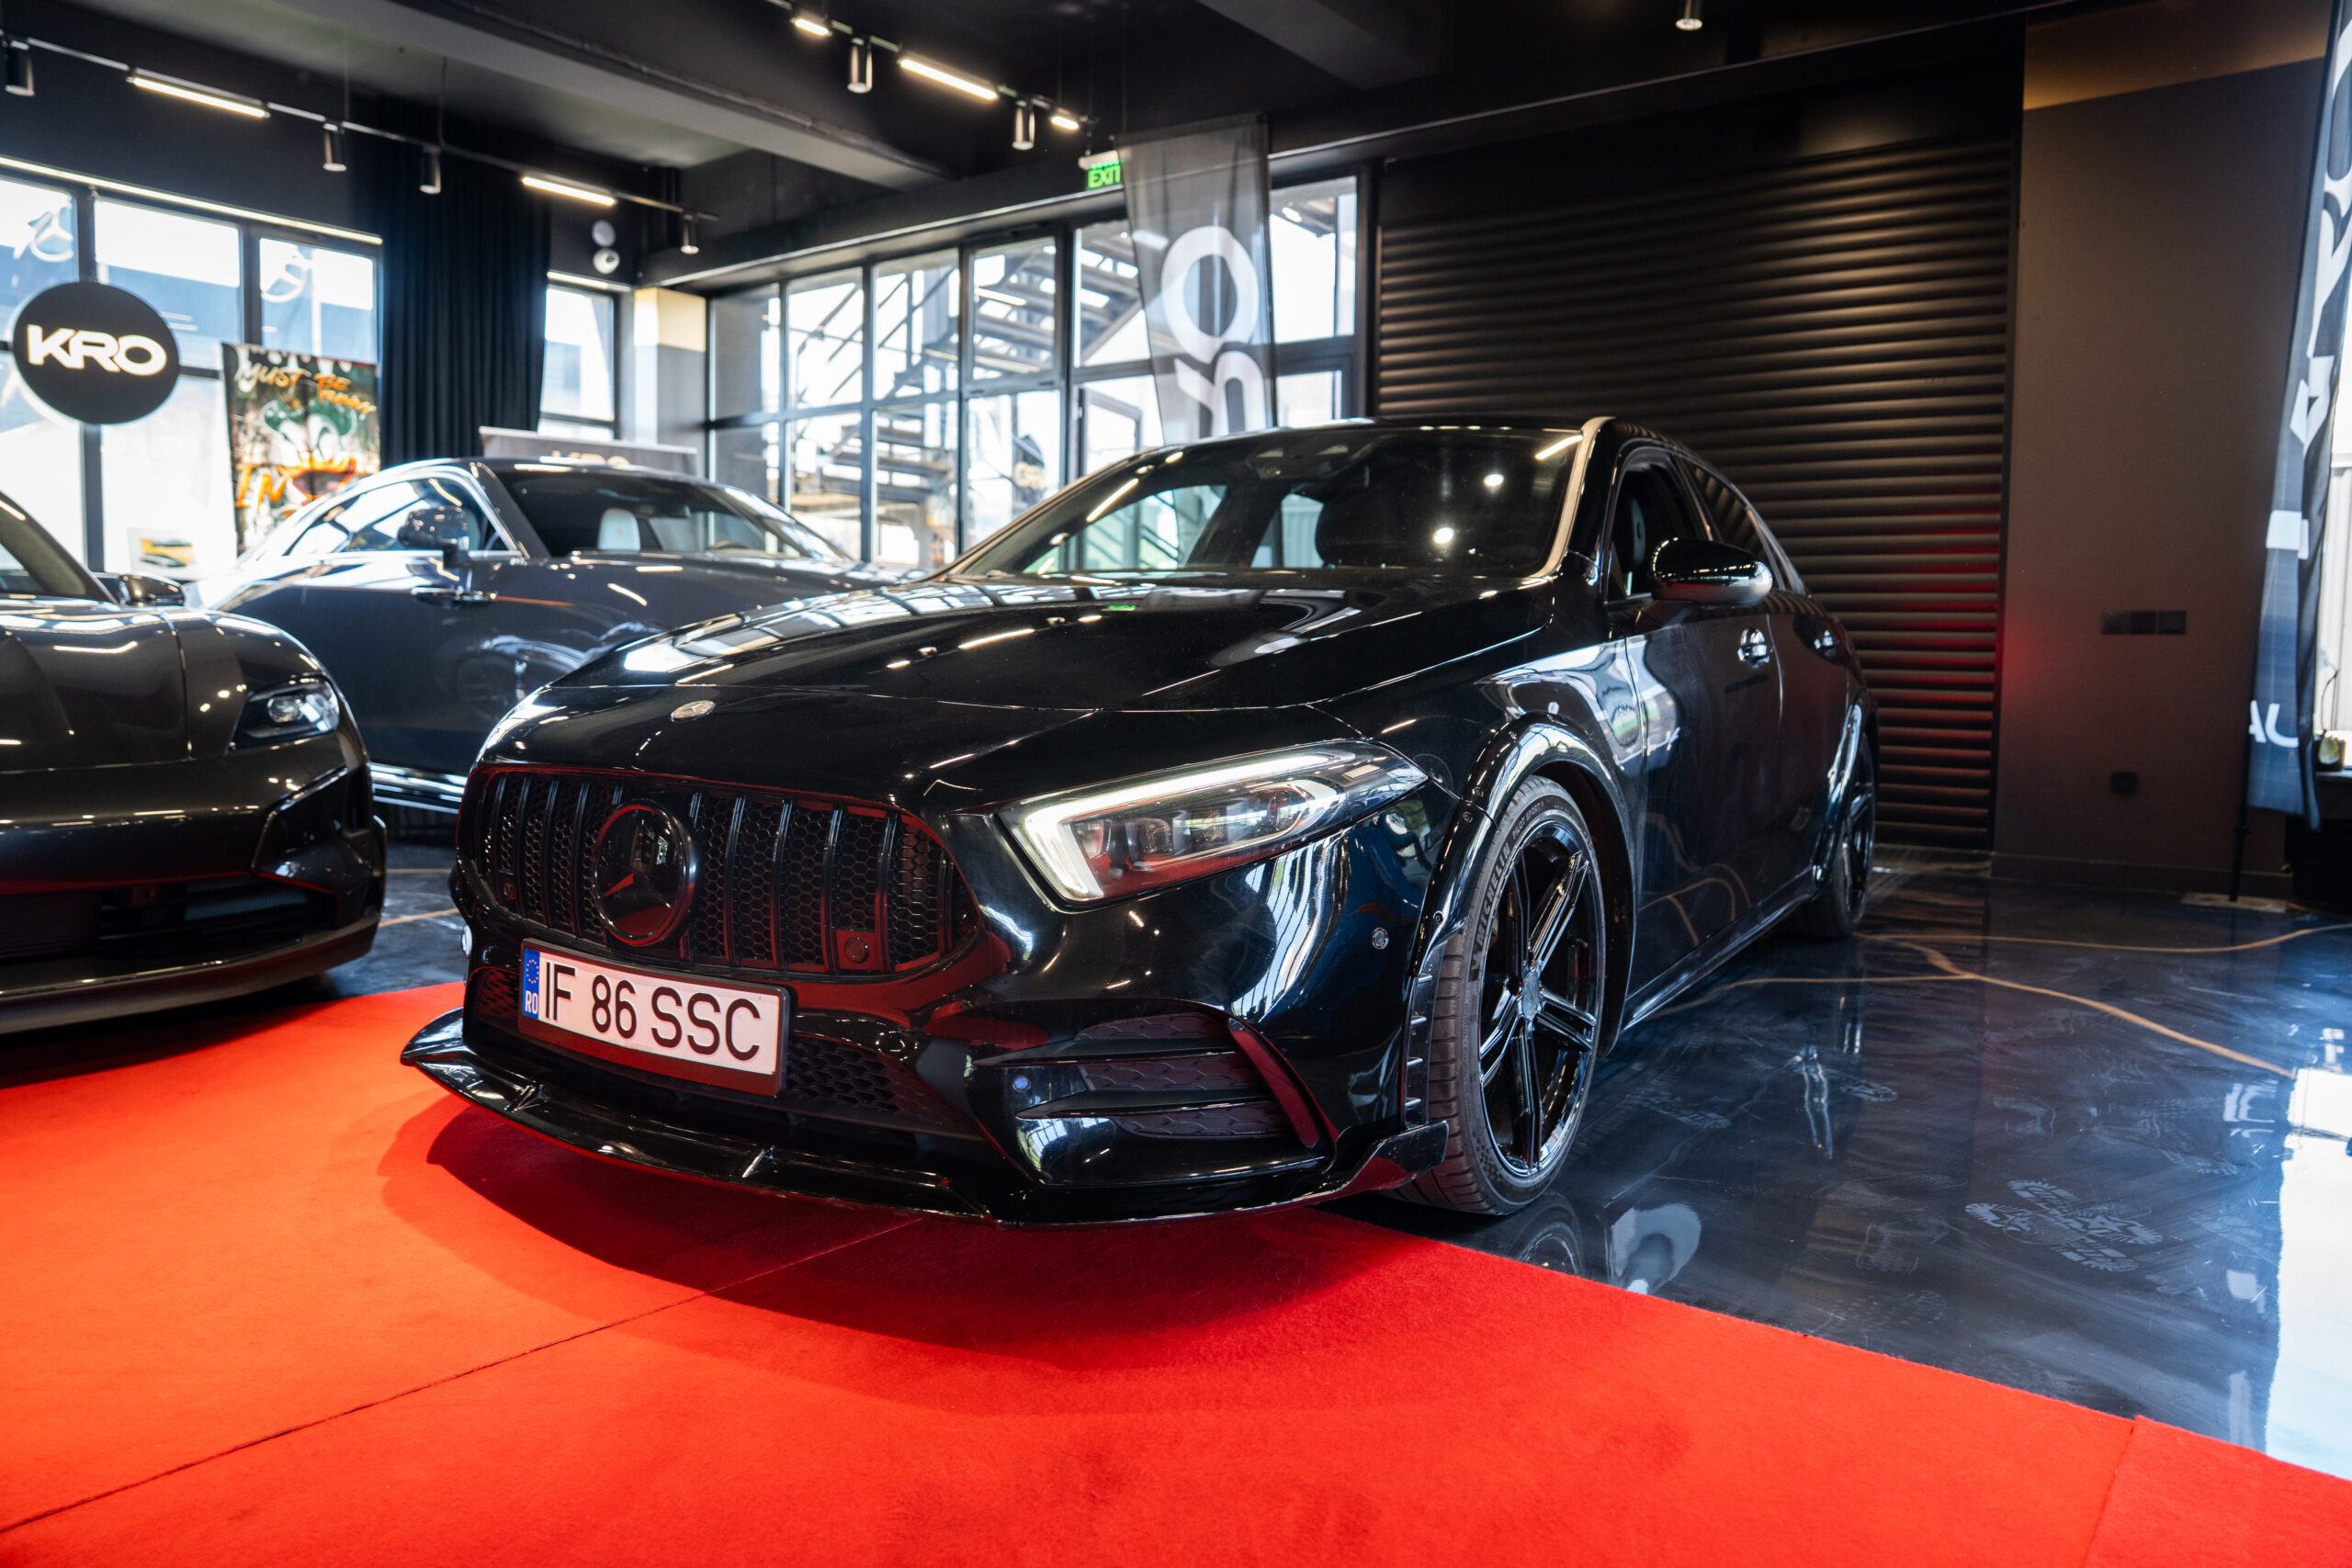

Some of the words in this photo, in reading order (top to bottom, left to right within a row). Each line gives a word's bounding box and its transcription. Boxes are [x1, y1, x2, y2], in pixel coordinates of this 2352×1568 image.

[27, 324, 167, 377] KRO
[1476, 842, 1510, 950] MICHELIN
[524, 990, 539, 1015] RO
[545, 961, 576, 1021] IF
[592, 974, 638, 1040] 86
[650, 986, 762, 1062] SSC
